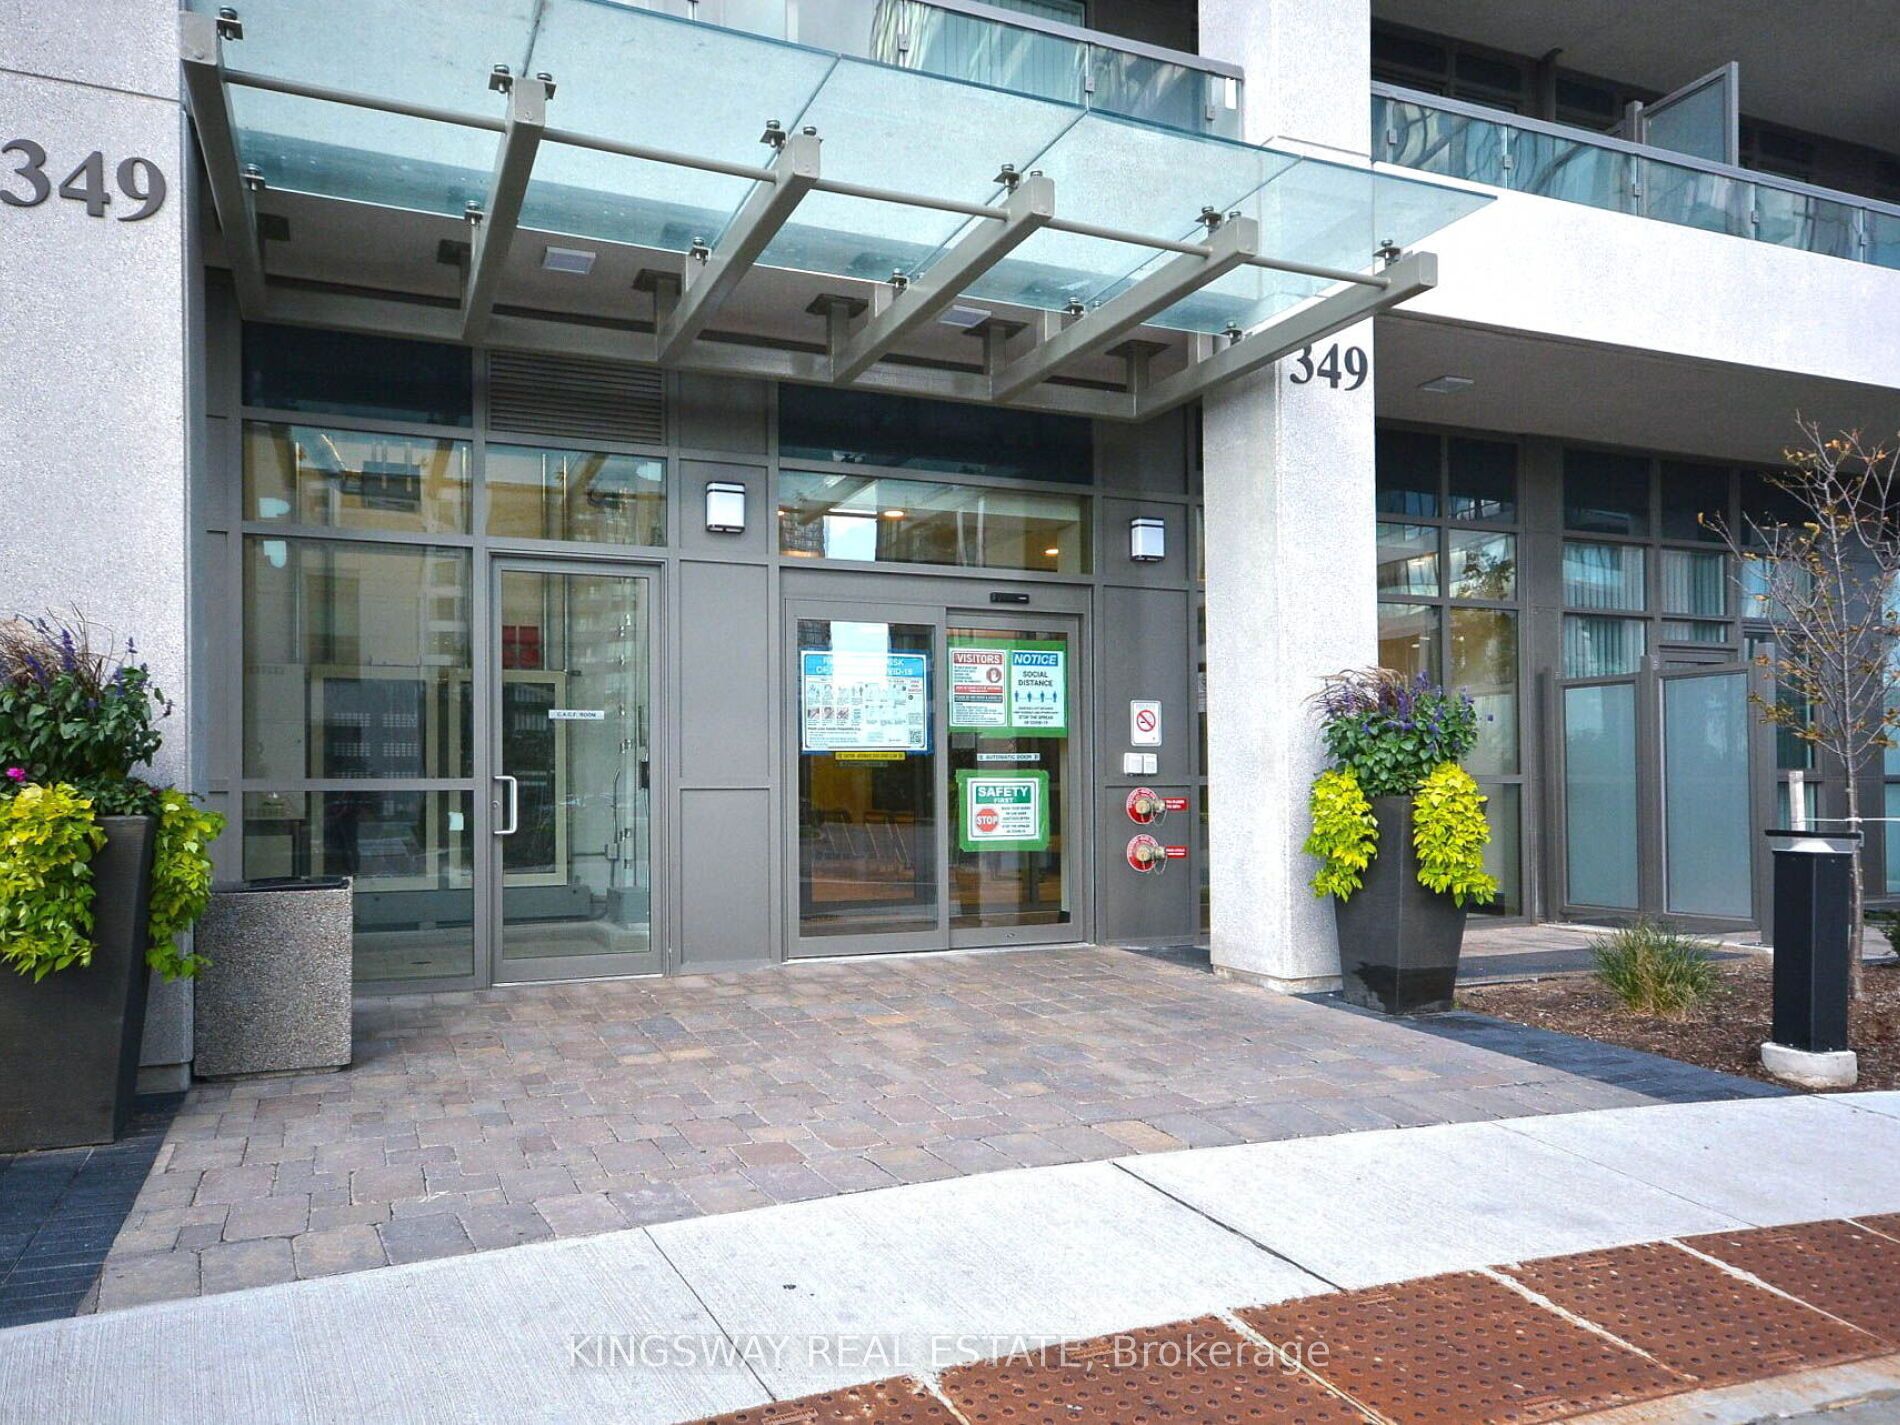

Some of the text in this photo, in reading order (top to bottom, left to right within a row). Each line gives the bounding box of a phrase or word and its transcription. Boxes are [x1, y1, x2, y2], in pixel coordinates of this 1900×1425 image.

[0, 139, 167, 222] 349
[1290, 343, 1368, 391] 349
[956, 653, 1001, 664] VISITORS
[1014, 654, 1057, 665] NOTICE
[977, 786, 1028, 797] SAFETY
[976, 816, 998, 825] STOP
